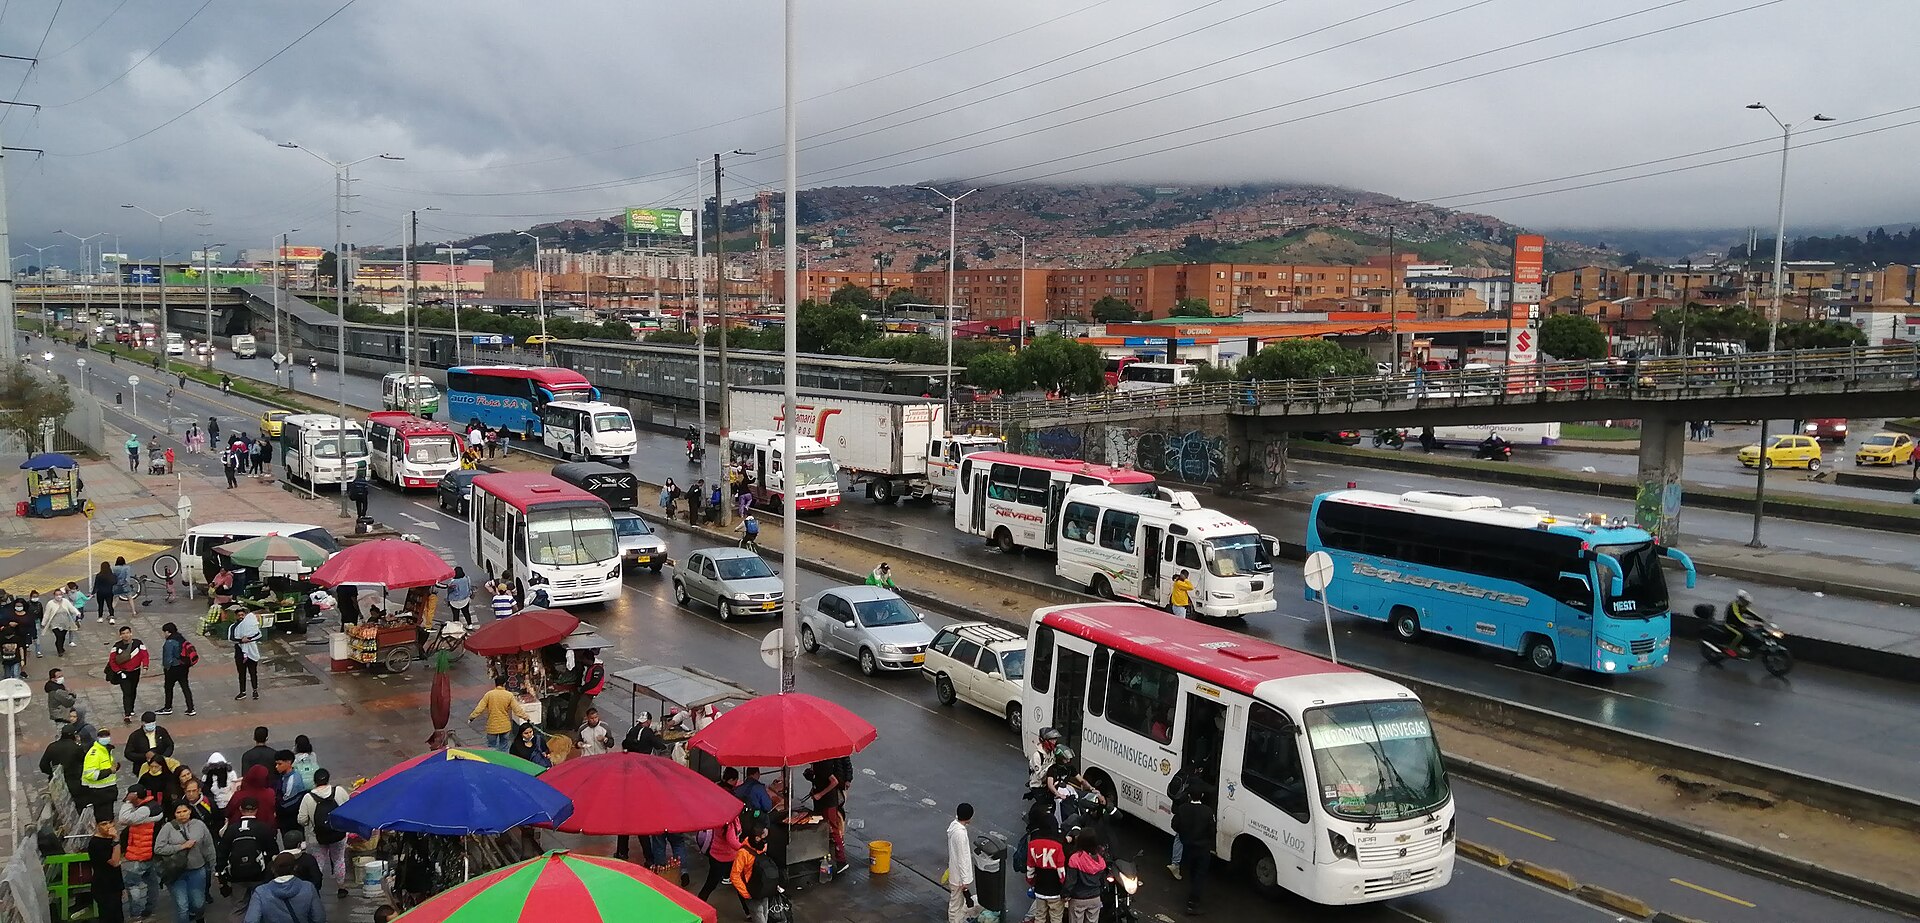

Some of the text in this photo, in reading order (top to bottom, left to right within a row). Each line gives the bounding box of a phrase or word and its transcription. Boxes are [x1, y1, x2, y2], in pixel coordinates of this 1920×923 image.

[450, 394, 476, 404] auto
[995, 510, 1044, 524] NEVADA
[1353, 561, 1530, 607] Tequendama
[1083, 727, 1158, 772] COOPINTRANSVEGAS
[1424, 825, 1442, 836] GMC
[1282, 829, 1306, 852] V002
